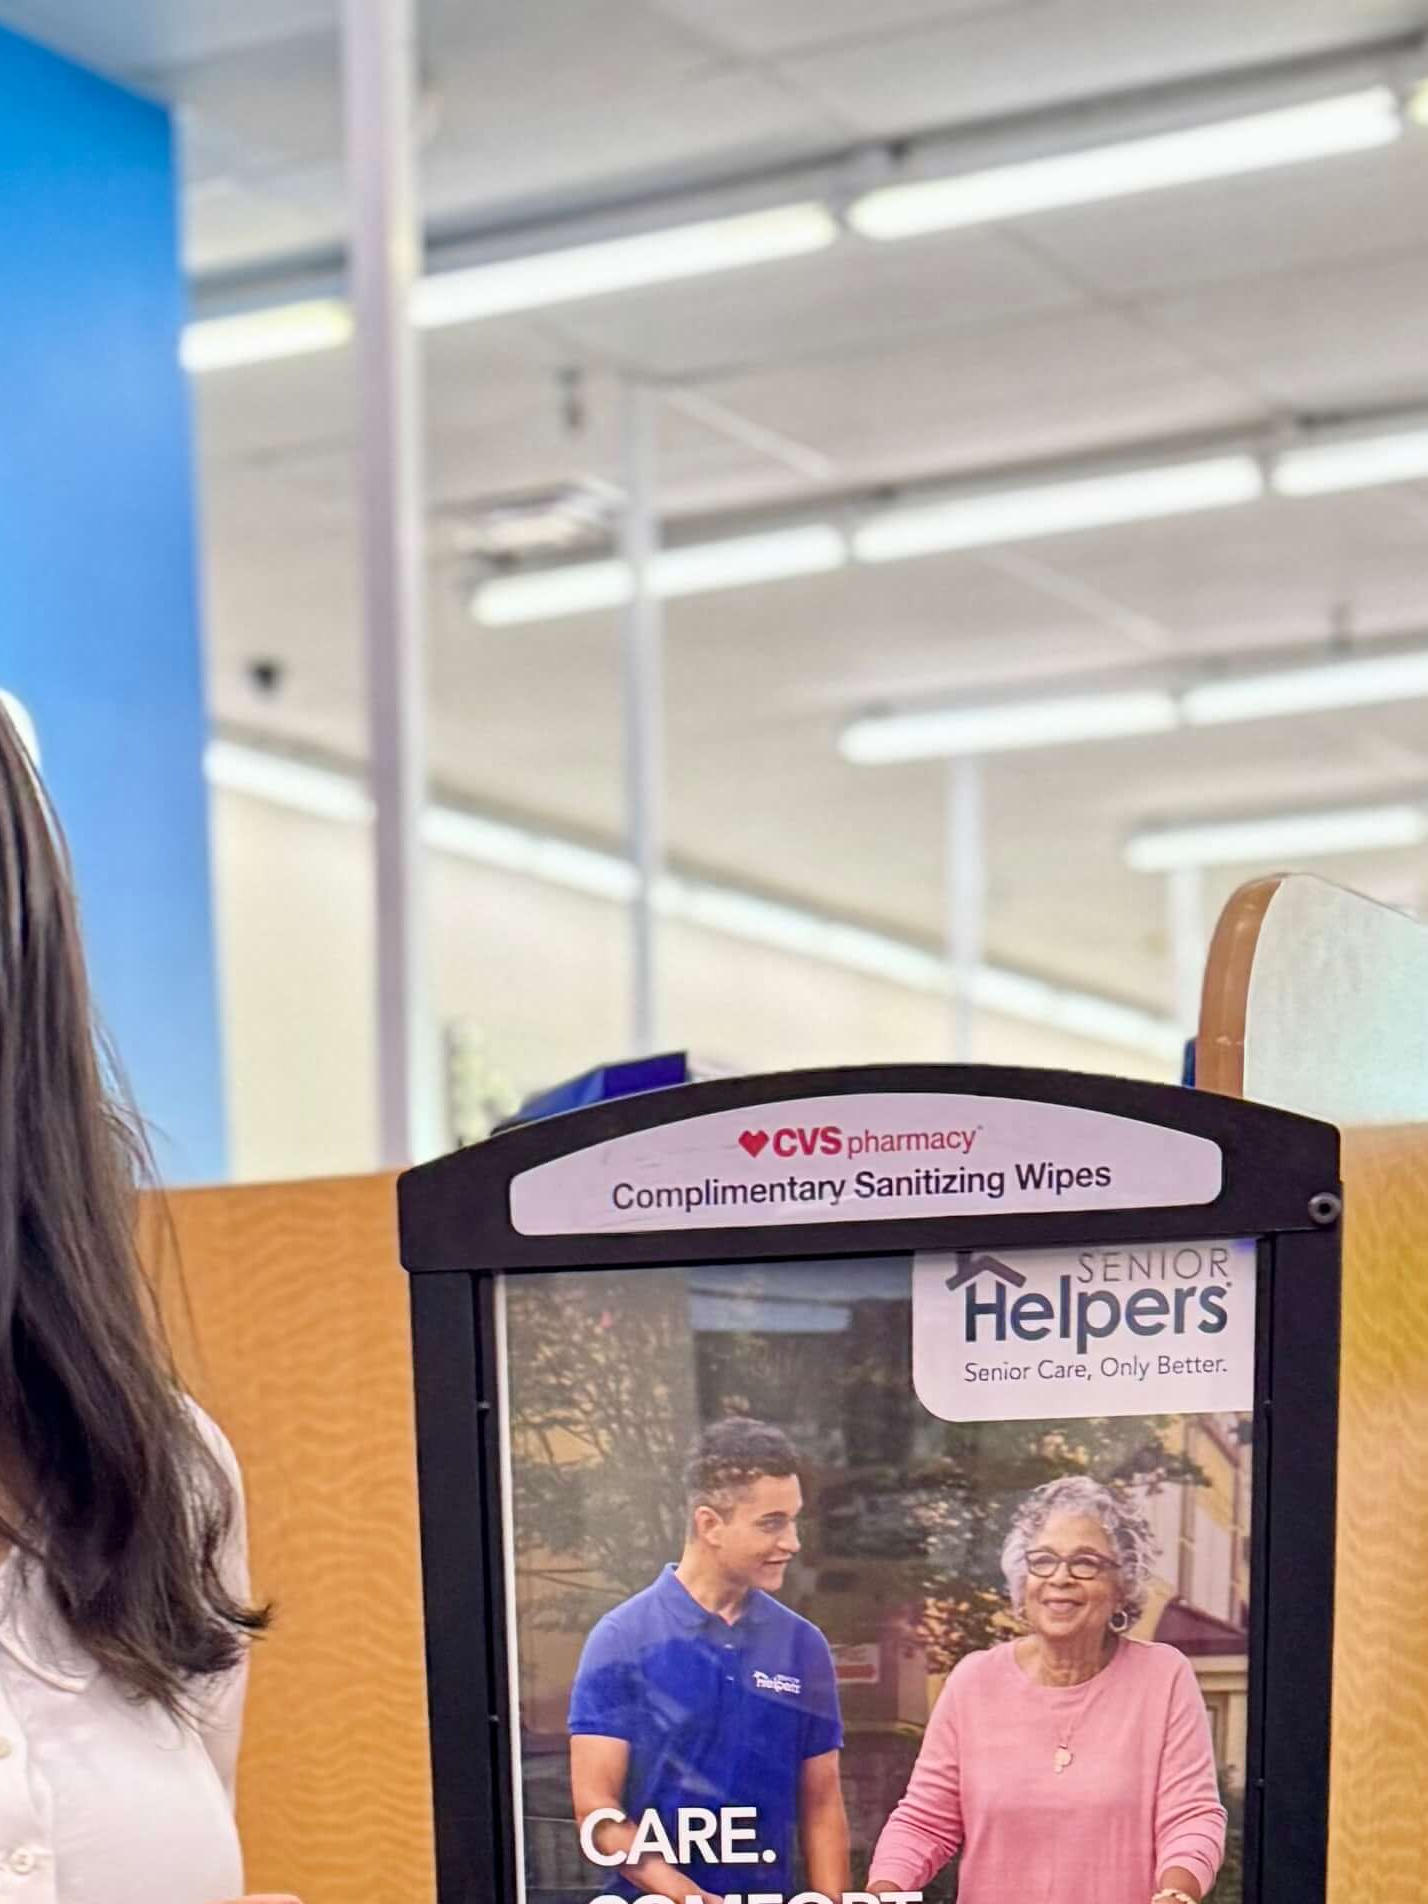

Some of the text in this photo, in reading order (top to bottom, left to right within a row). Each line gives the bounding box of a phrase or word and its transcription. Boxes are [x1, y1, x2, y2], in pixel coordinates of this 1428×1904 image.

[773, 1125, 977, 1159] CVS pharmacy
[612, 1161, 1111, 1212] Complimentary Sanitizing Wipes
[1078, 1248, 1229, 1283] SENIOR
[963, 1277, 1229, 1353] Helpers
[964, 1355, 1228, 1384] Senior Care, Only Better.
[581, 1807, 776, 1866] CARE.
